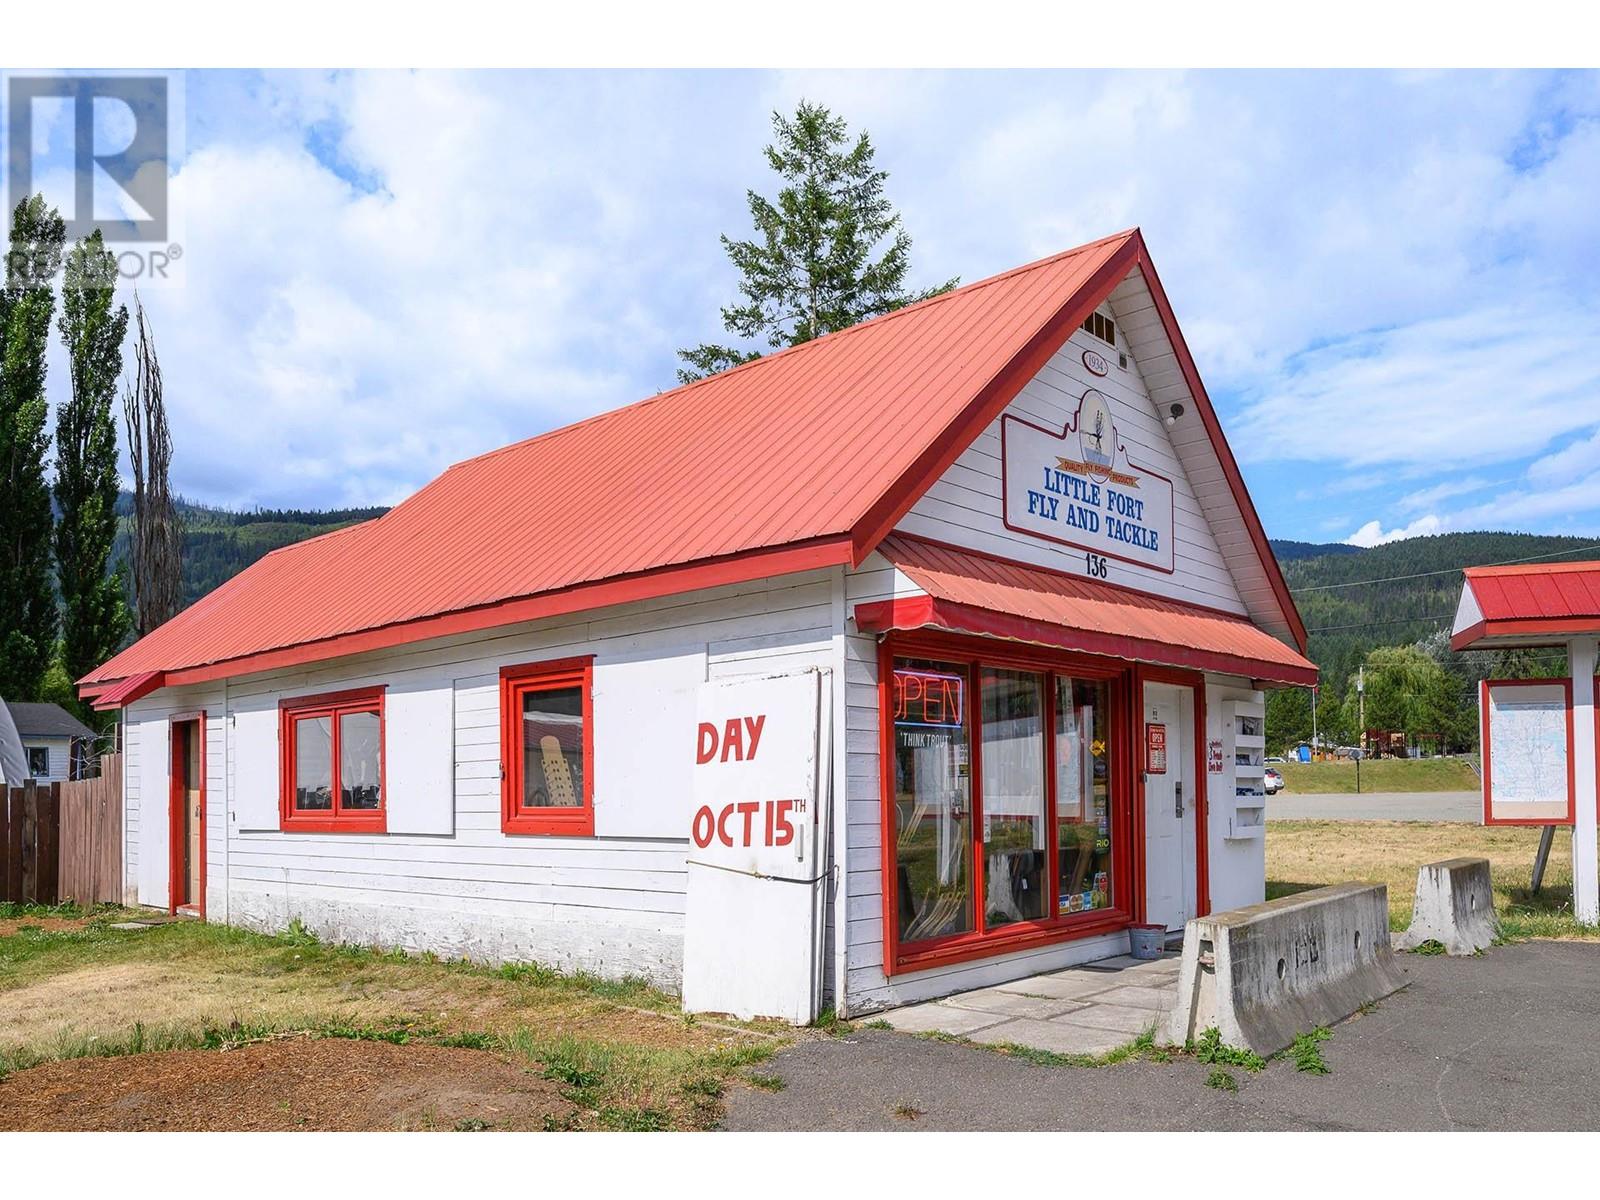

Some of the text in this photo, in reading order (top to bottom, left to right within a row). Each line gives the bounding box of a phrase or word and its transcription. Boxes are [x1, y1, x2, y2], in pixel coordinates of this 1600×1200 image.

[1088, 354, 1104, 372] 1934
[1064, 461, 1084, 472] QUALITY
[1043, 467, 1144, 521] LITTLE FORT
[1027, 490, 1159, 552] FLY AND TACKLE
[1085, 553, 1107, 579] 136
[696, 714, 766, 764] DAY
